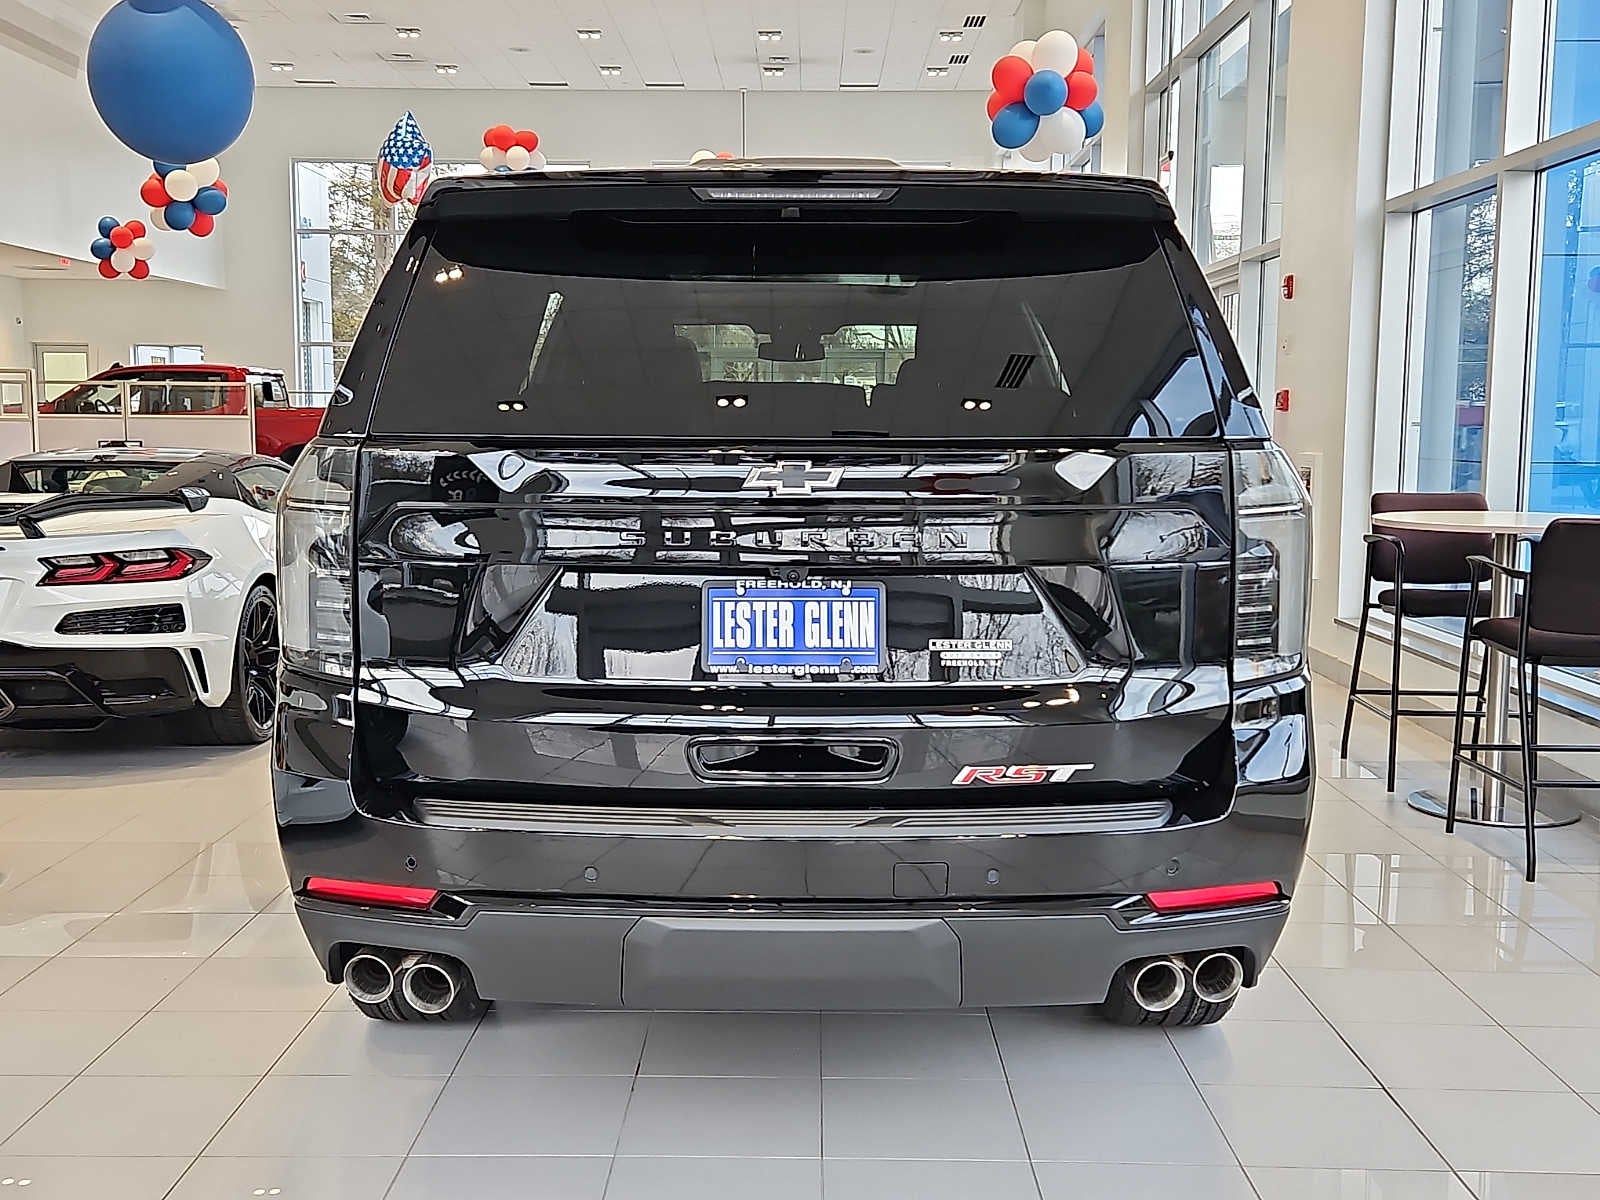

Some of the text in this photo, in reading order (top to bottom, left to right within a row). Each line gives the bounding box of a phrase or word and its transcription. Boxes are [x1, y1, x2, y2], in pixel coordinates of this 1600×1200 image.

[619, 530, 968, 549] SUBURBAN
[830, 579, 852, 590] NJ
[712, 601, 876, 649] LESTER GLENN
[929, 640, 1012, 650] LESTER GLENN
[951, 763, 1096, 785] RST
